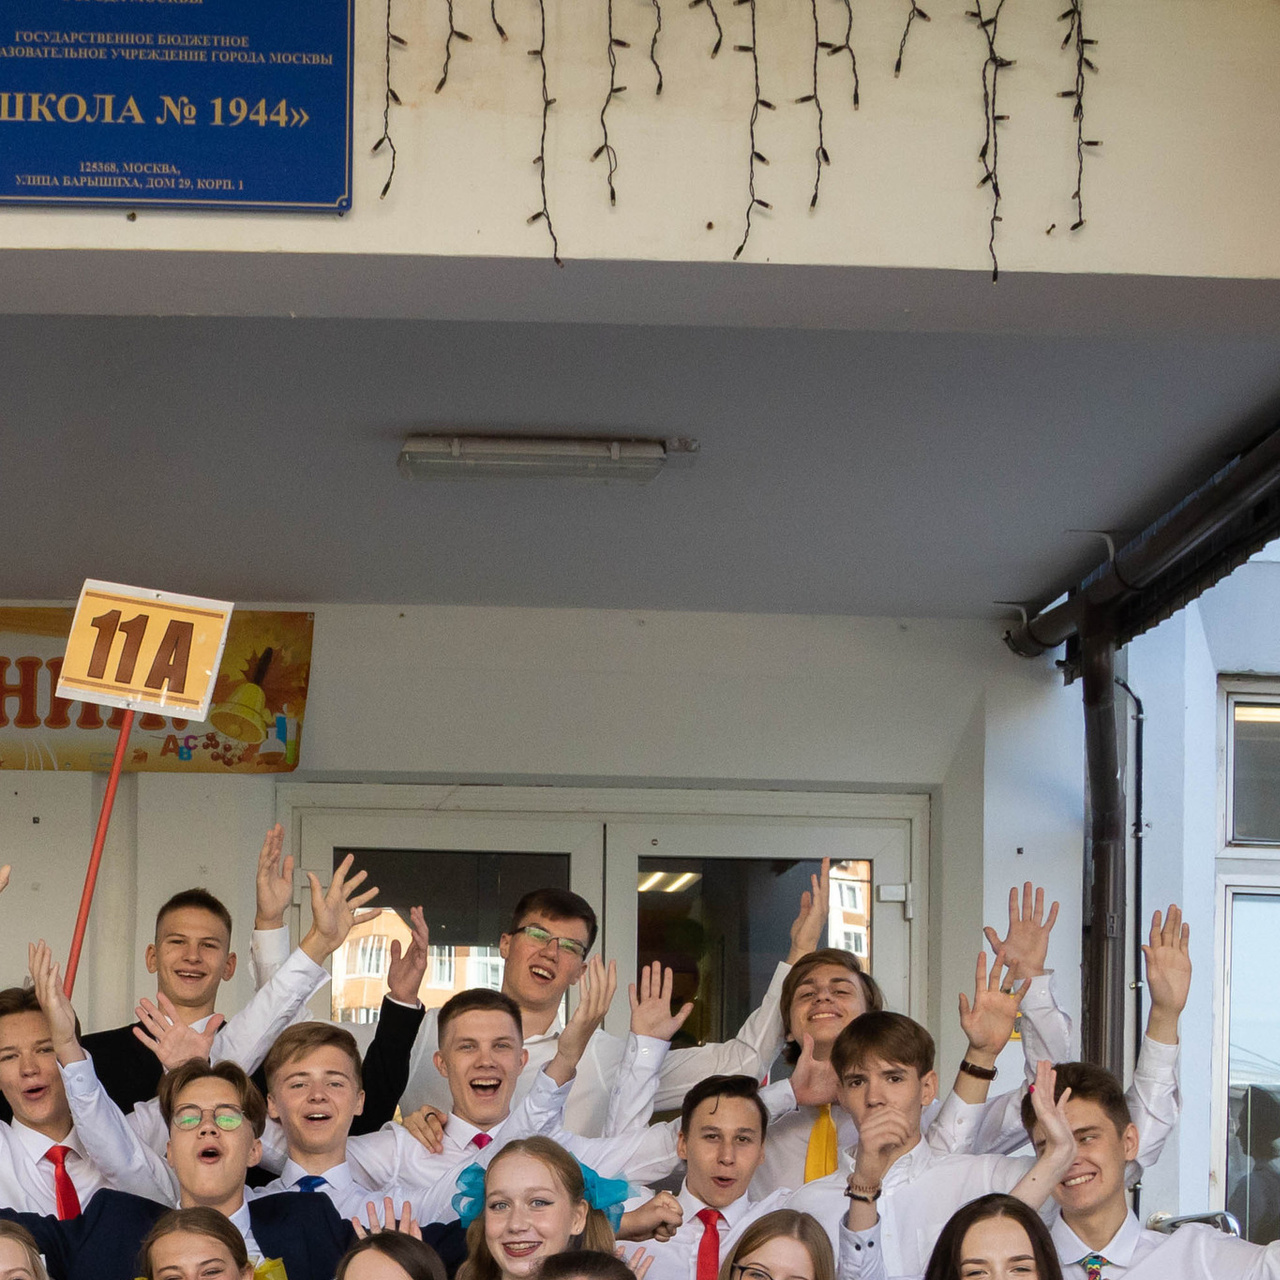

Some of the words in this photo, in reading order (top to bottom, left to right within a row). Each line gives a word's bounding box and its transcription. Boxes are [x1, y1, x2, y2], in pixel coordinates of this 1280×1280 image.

[15, 31, 154, 45] ГОСУДАРСТВЕННОЕ
[157, 34, 249, 48] БЮДЖЕТНОЕ
[111, 48, 207, 62] УЧРЕЖДЕНИЕ
[211, 51, 266, 63] ГОРОДА
[269, 52, 334, 65] МОСКВЫ
[156, 96, 197, 125] №
[209, 97, 310, 128] 1944»
[79, 161, 119, 174] 125368,
[122, 162, 181, 175] МОСКВА,
[15, 174, 60, 187] УЛИЦА
[62, 175, 143, 188] БАРЫШИХА,
[145, 177, 175, 189] ДОМ
[178, 178, 194, 190] 29,
[196, 179, 235, 191] КОРП.
[238, 179, 245, 190] 1
[87, 609, 194, 693] 11А
